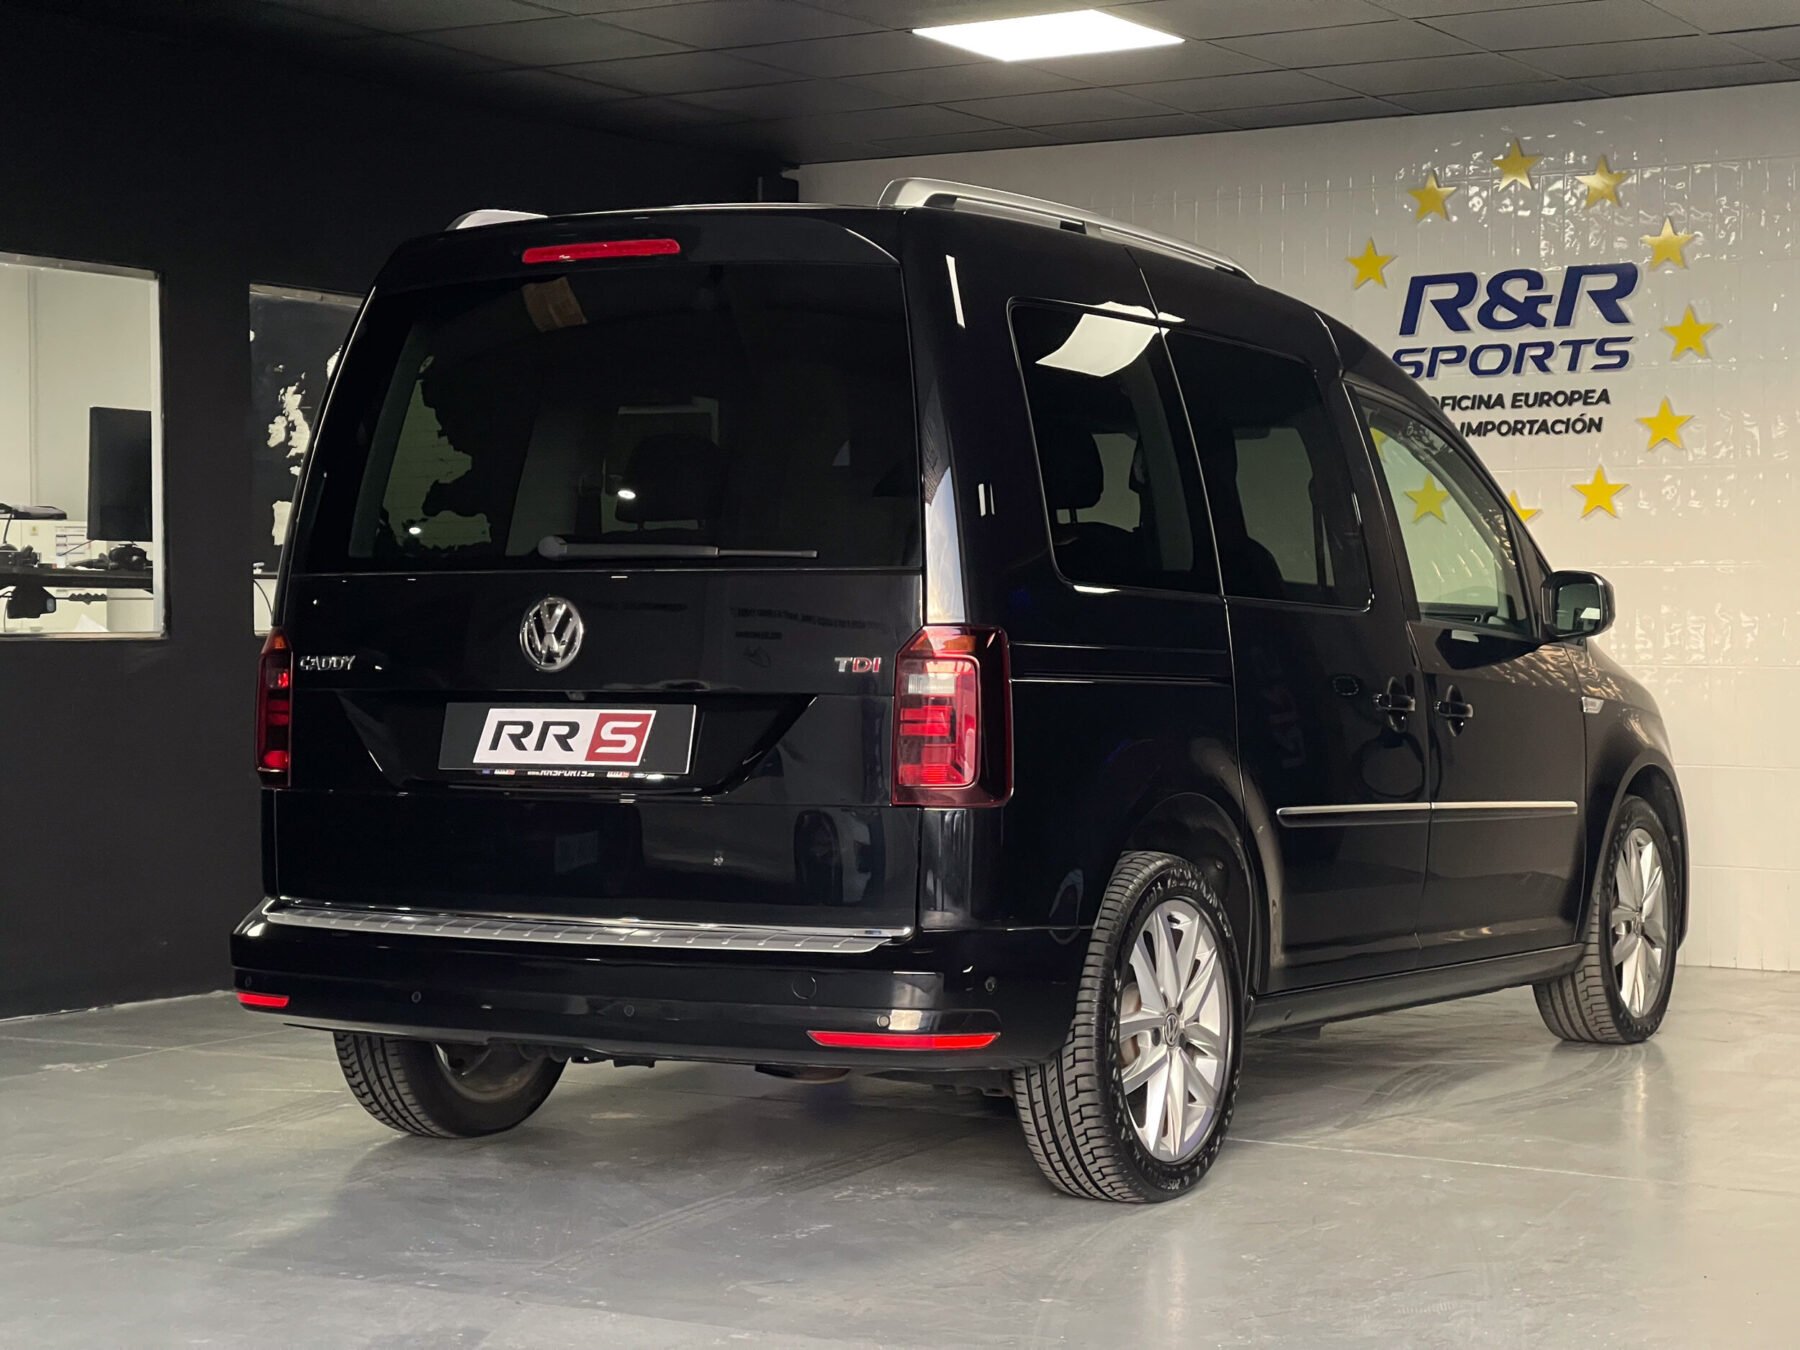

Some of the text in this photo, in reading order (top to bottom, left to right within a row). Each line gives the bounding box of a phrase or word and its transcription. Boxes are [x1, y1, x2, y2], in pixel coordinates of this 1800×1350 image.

[1398, 261, 1639, 336] R&R
[1391, 335, 1635, 380] SPORTS
[1510, 388, 1611, 410] EUROPEA
[1459, 413, 1603, 438] IMPORTACIÓN
[300, 655, 356, 670] CADDY
[834, 656, 882, 673] TDI
